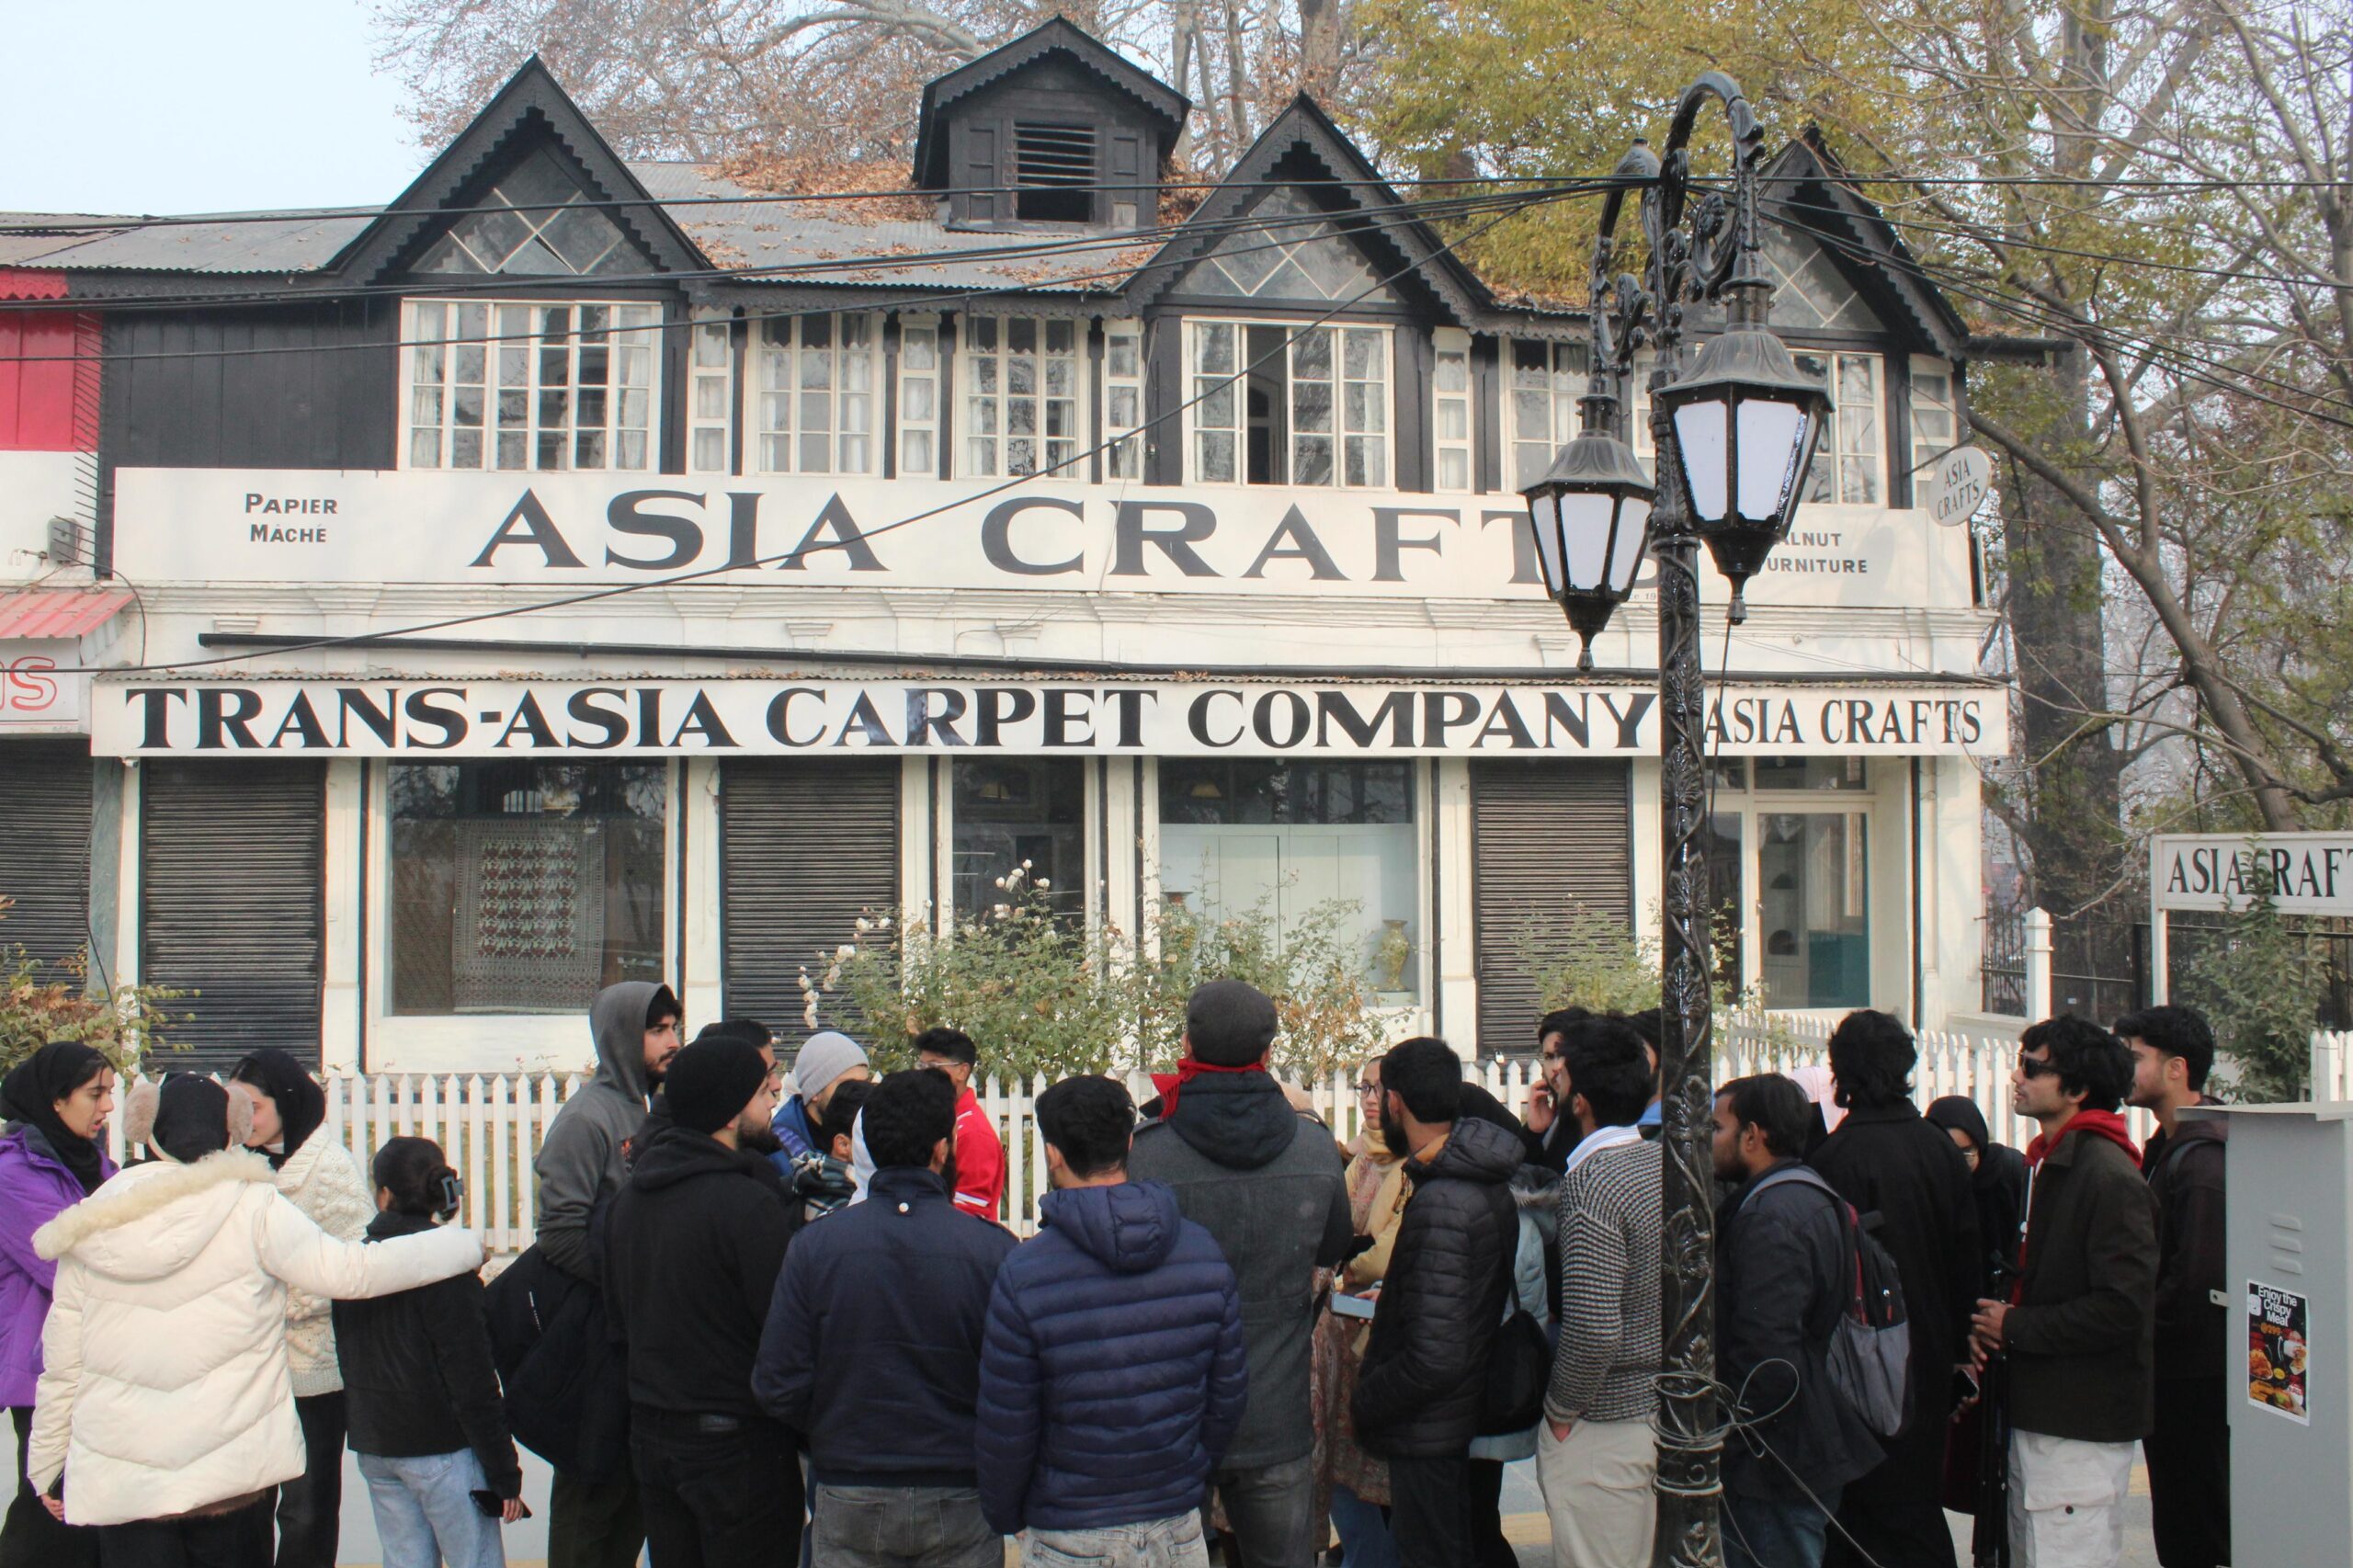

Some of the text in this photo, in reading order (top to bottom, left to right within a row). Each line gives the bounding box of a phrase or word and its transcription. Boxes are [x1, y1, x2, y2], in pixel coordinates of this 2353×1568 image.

[1943, 458, 1971, 490] ASIA
[244, 493, 338, 515] PAPIER
[1938, 478, 1980, 520] CRAFTS
[469, 488, 1660, 590] ASIA CRAFT
[1779, 531, 1842, 547] LNUT
[1766, 557, 1868, 574] URNITURE
[0, 655, 57, 711] S
[125, 687, 1658, 749] TRANS-ASIA CARPET COMPANY
[1703, 698, 1981, 744] ASIA CRAFTS
[2166, 847, 2353, 898] ASIA RAF
[2282, 1292, 2298, 1307] the
